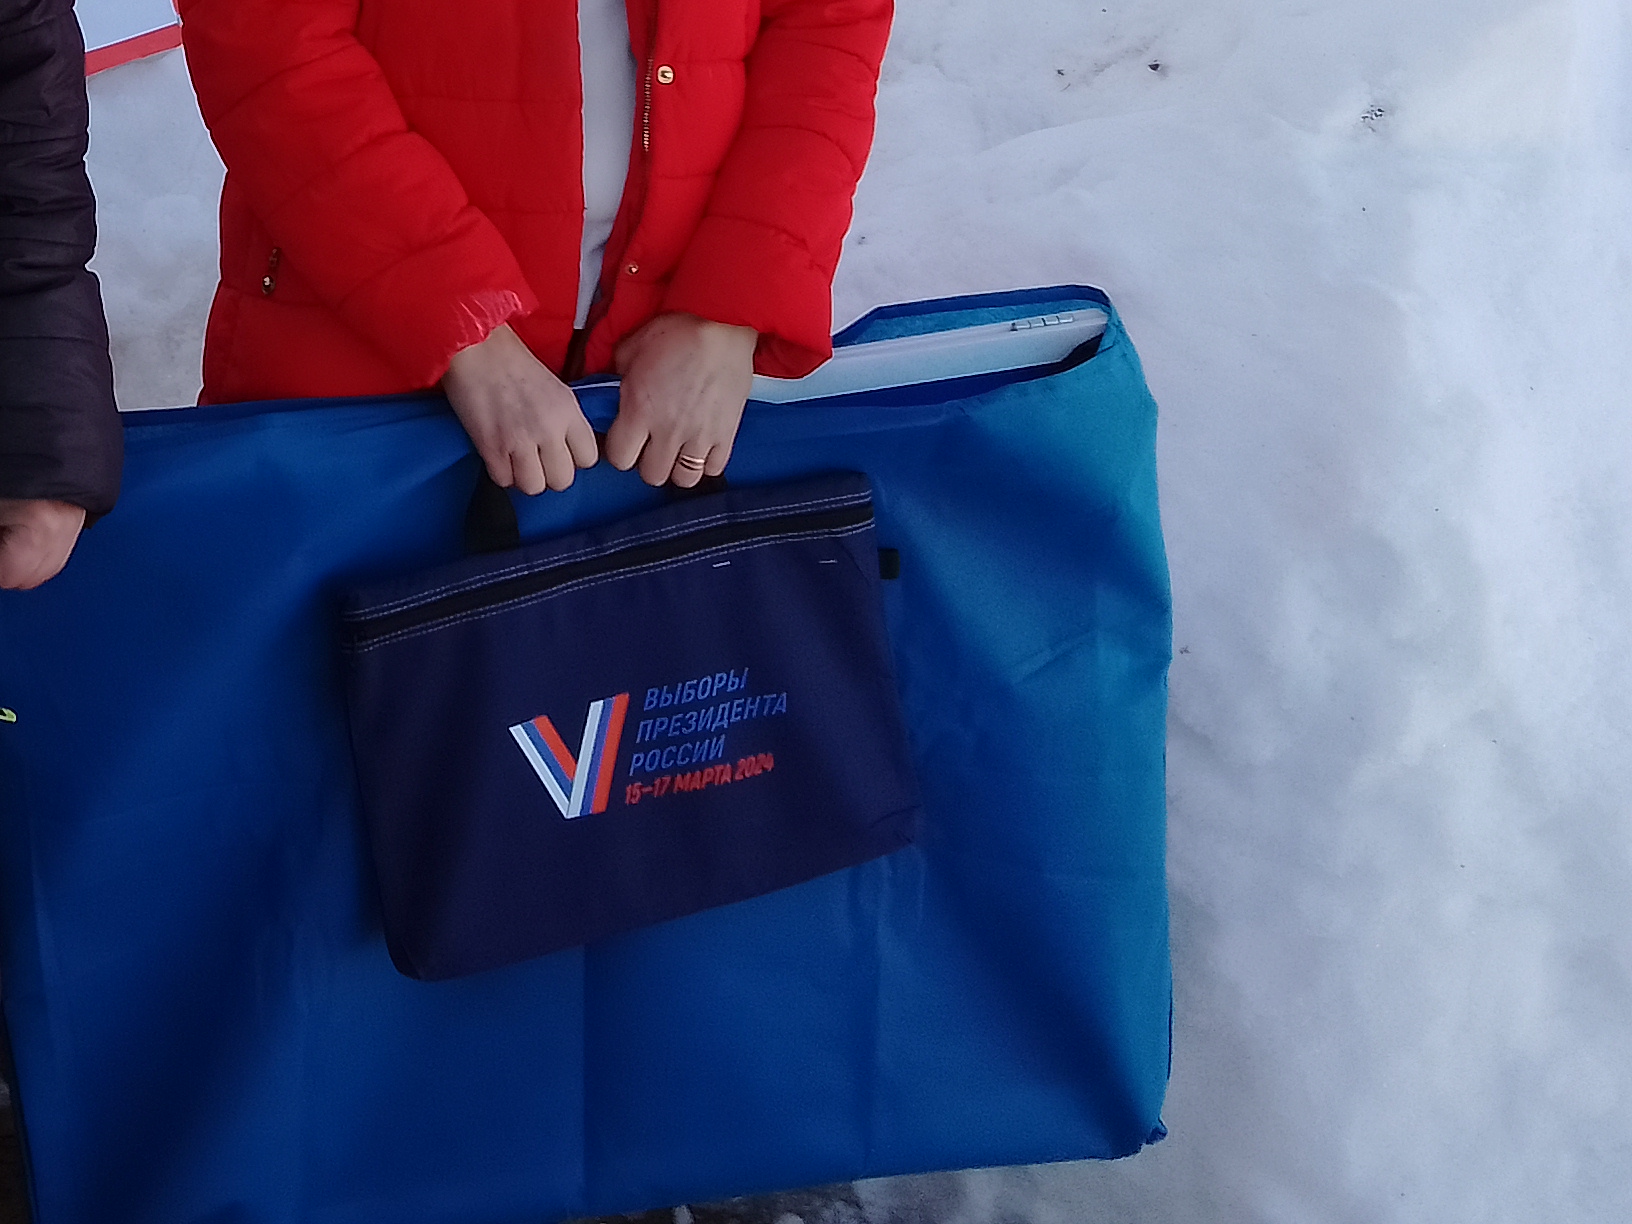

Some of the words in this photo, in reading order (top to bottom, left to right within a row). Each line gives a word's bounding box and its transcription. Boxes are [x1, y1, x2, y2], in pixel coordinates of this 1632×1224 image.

[643, 666, 750, 712] ВЫБОРЫ
[635, 691, 788, 744] ПРЕЗИДЕНТА
[628, 733, 726, 777] РОССИИ
[672, 762, 733, 794] МАРТА
